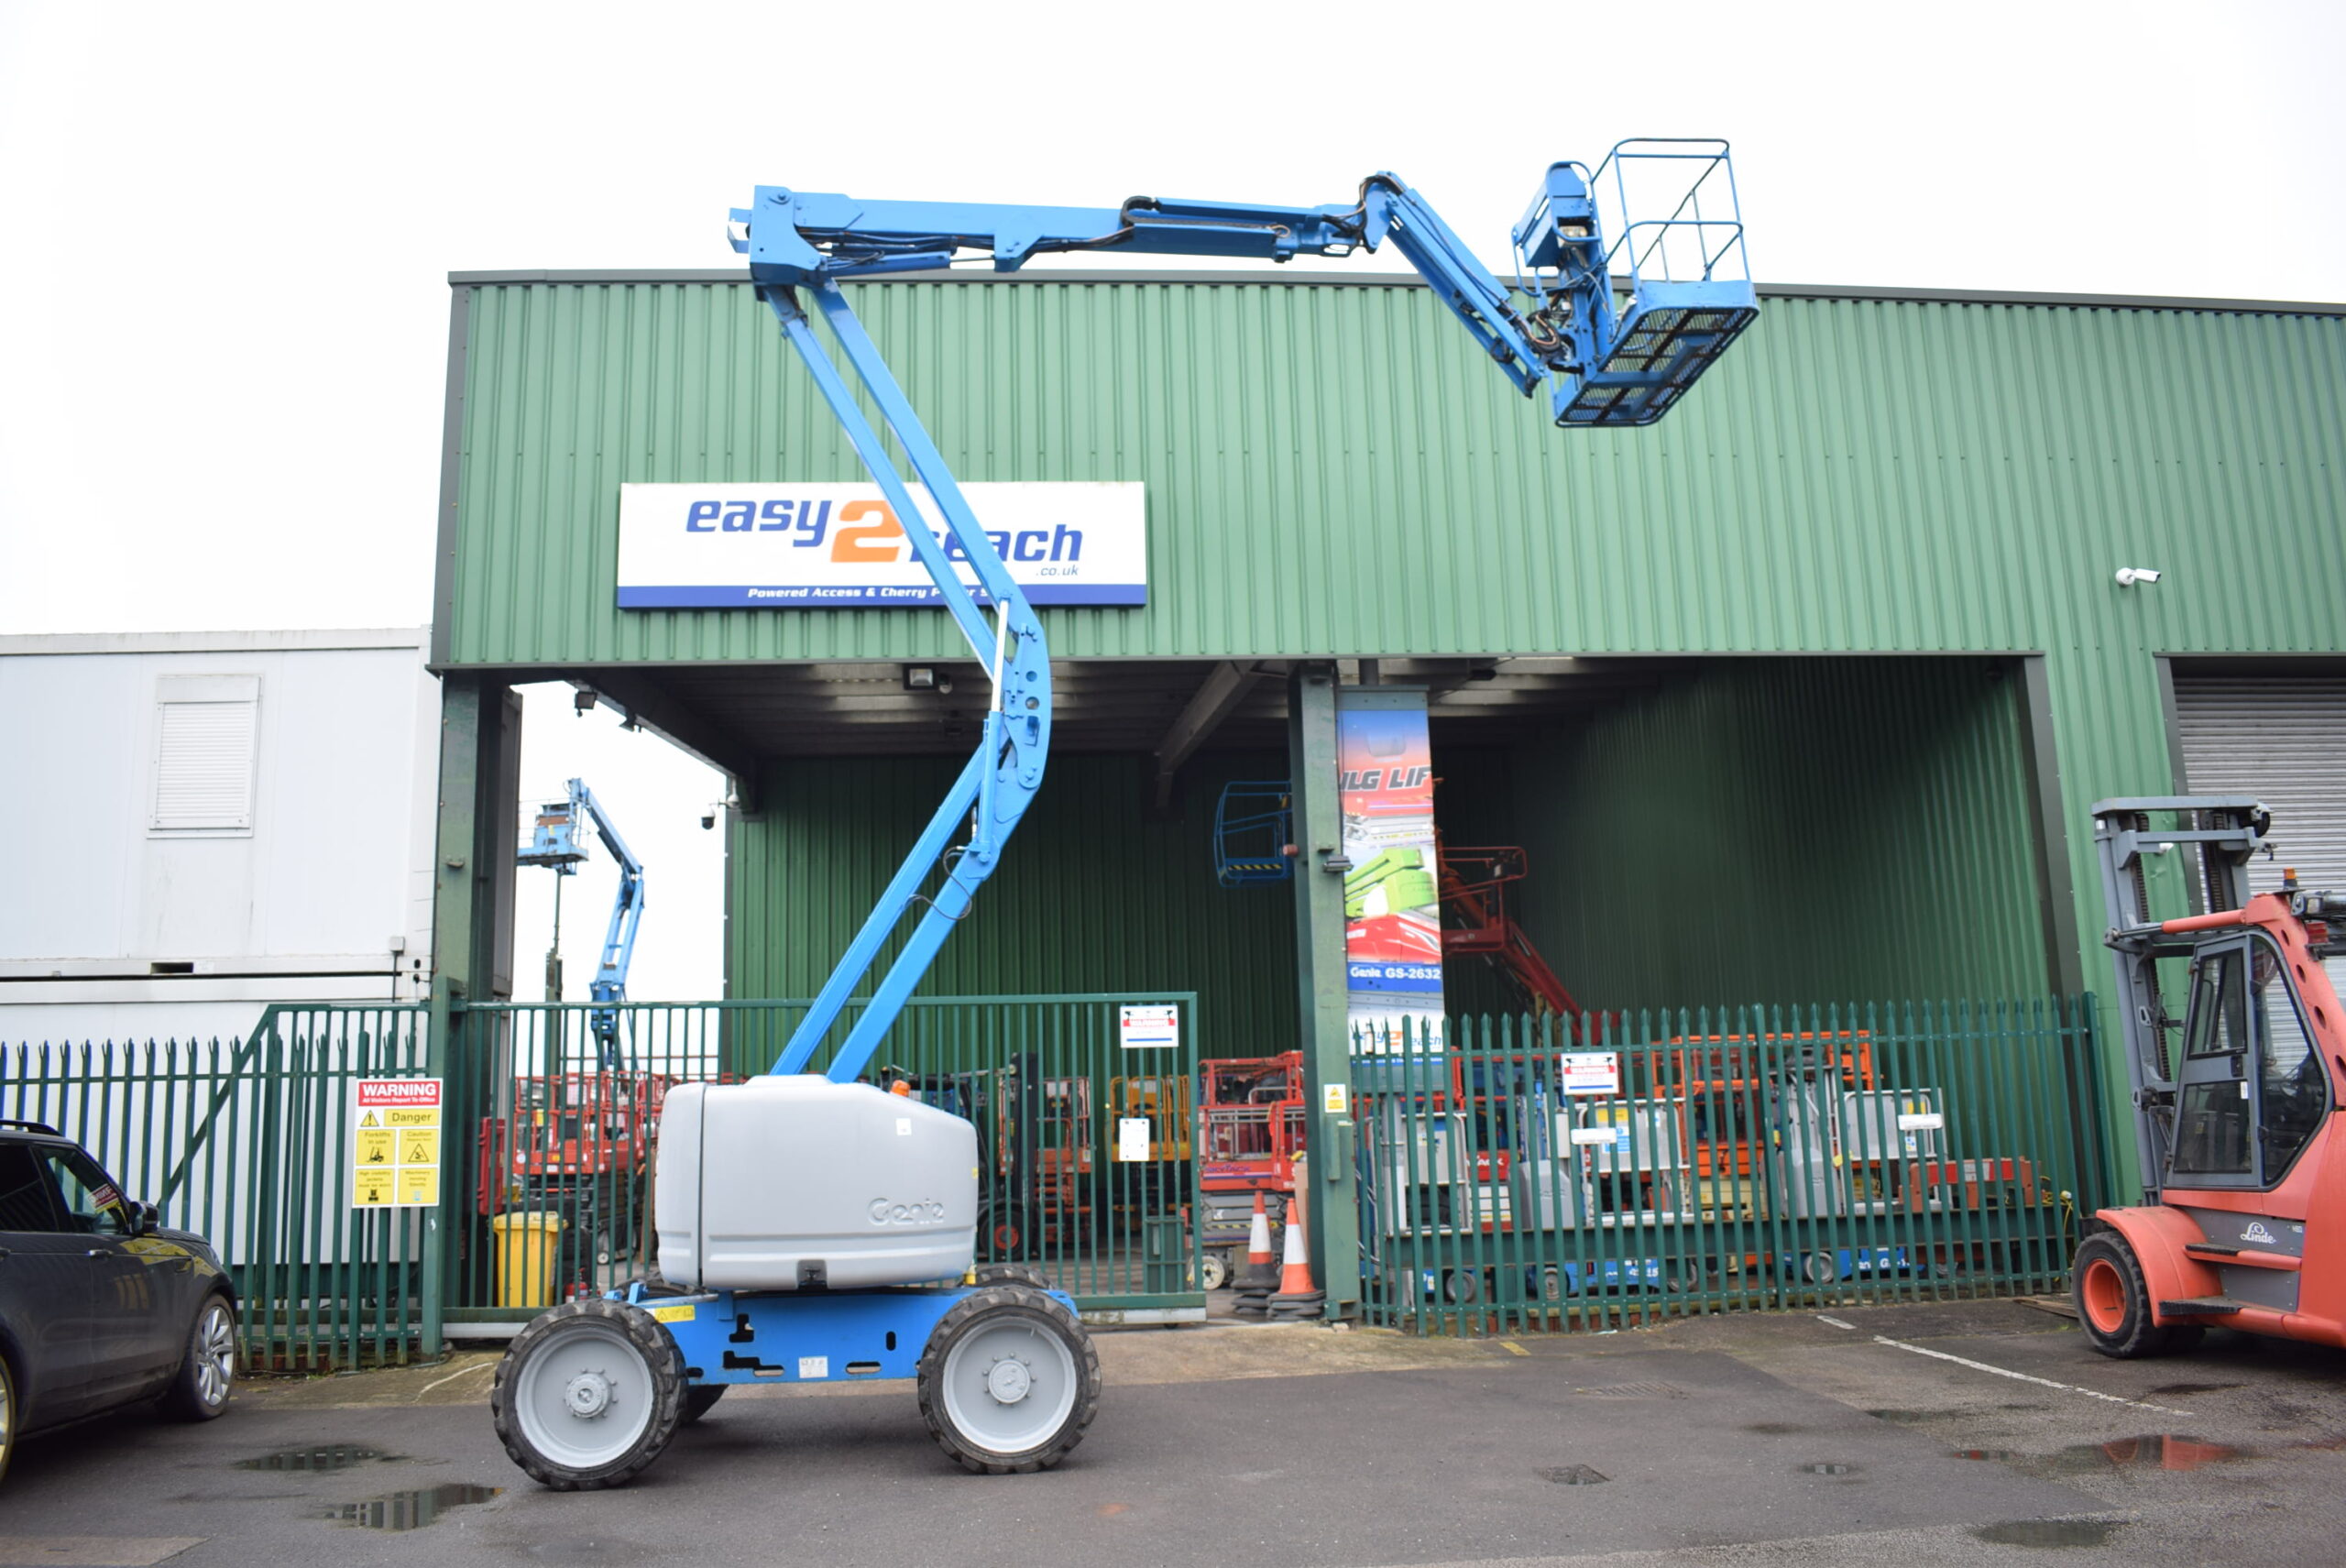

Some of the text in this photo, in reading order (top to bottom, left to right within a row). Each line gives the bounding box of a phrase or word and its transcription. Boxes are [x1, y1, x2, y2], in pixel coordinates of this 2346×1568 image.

[1036, 565, 1079, 576] .co.uk
[748, 587, 808, 598] Powered
[812, 587, 861, 598] Access
[866, 587, 875, 598] &
[881, 587, 926, 599] Cherry
[1385, 967, 1442, 979] GS-2632
[362, 1083, 436, 1096] WARNING
[391, 1113, 432, 1124] Danger
[867, 1197, 944, 1226] Genie
[2240, 1222, 2275, 1245] Linde
